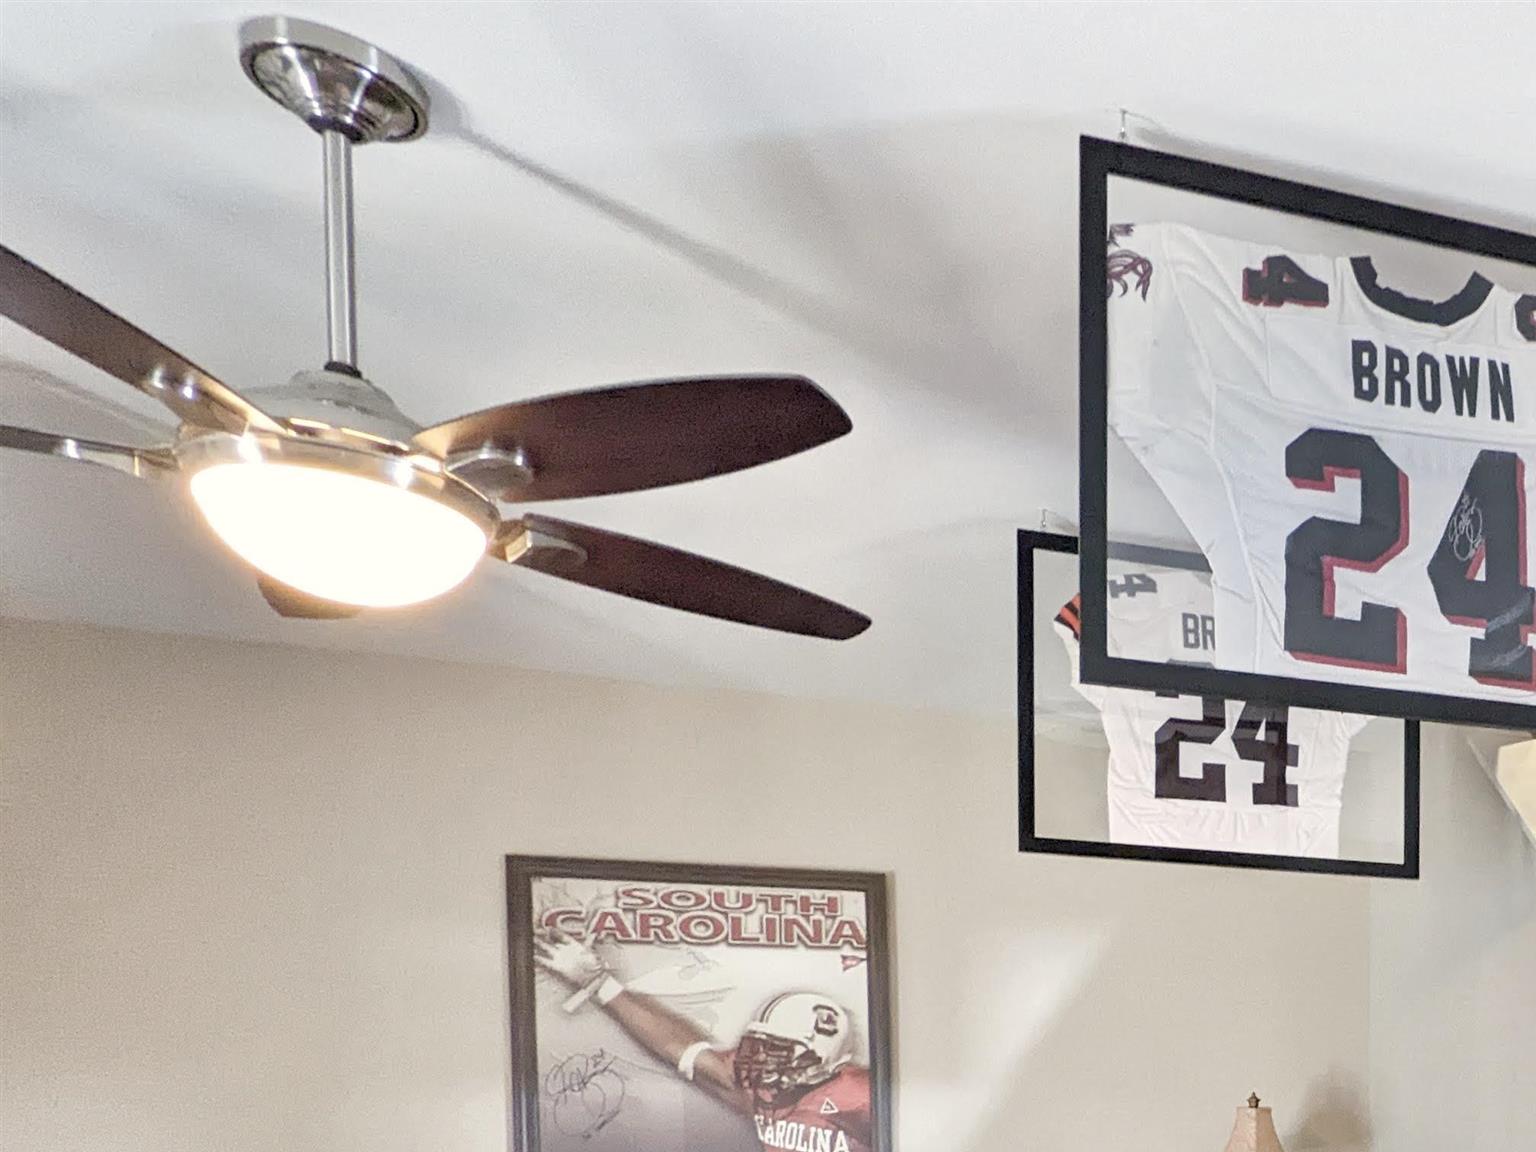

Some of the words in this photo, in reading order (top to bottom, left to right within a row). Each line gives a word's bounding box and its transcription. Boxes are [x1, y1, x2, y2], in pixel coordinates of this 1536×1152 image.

[1350, 338, 1516, 424] BROWN
[1155, 690, 1299, 807] 24
[541, 906, 867, 949] CAROLINA
[617, 885, 842, 917] SOUTH
